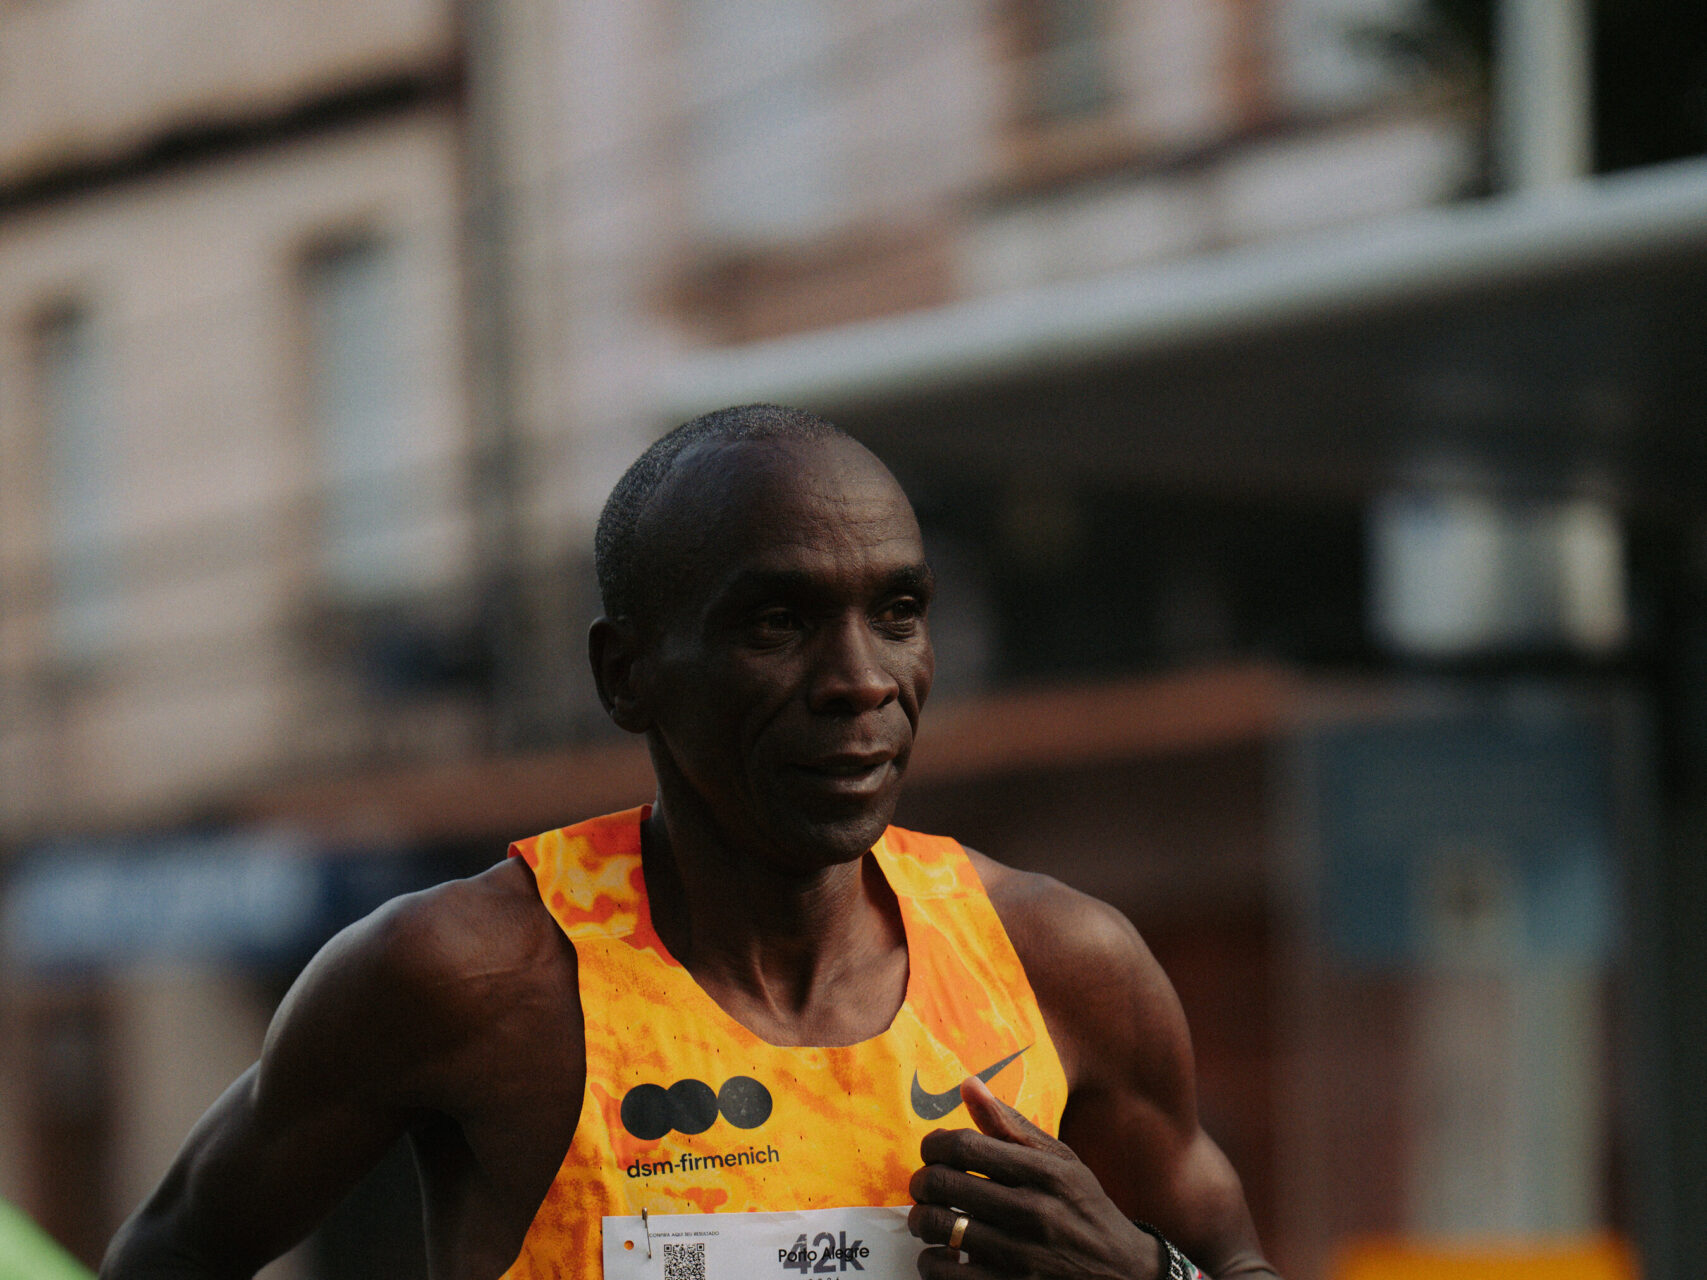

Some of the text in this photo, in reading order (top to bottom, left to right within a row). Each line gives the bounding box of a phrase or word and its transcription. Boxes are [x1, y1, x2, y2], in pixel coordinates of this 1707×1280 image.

[626, 1145, 780, 1178] dsm-firmenich
[778, 1246, 870, 1263] Porto Alegre
[783, 1230, 865, 1274] 42k
